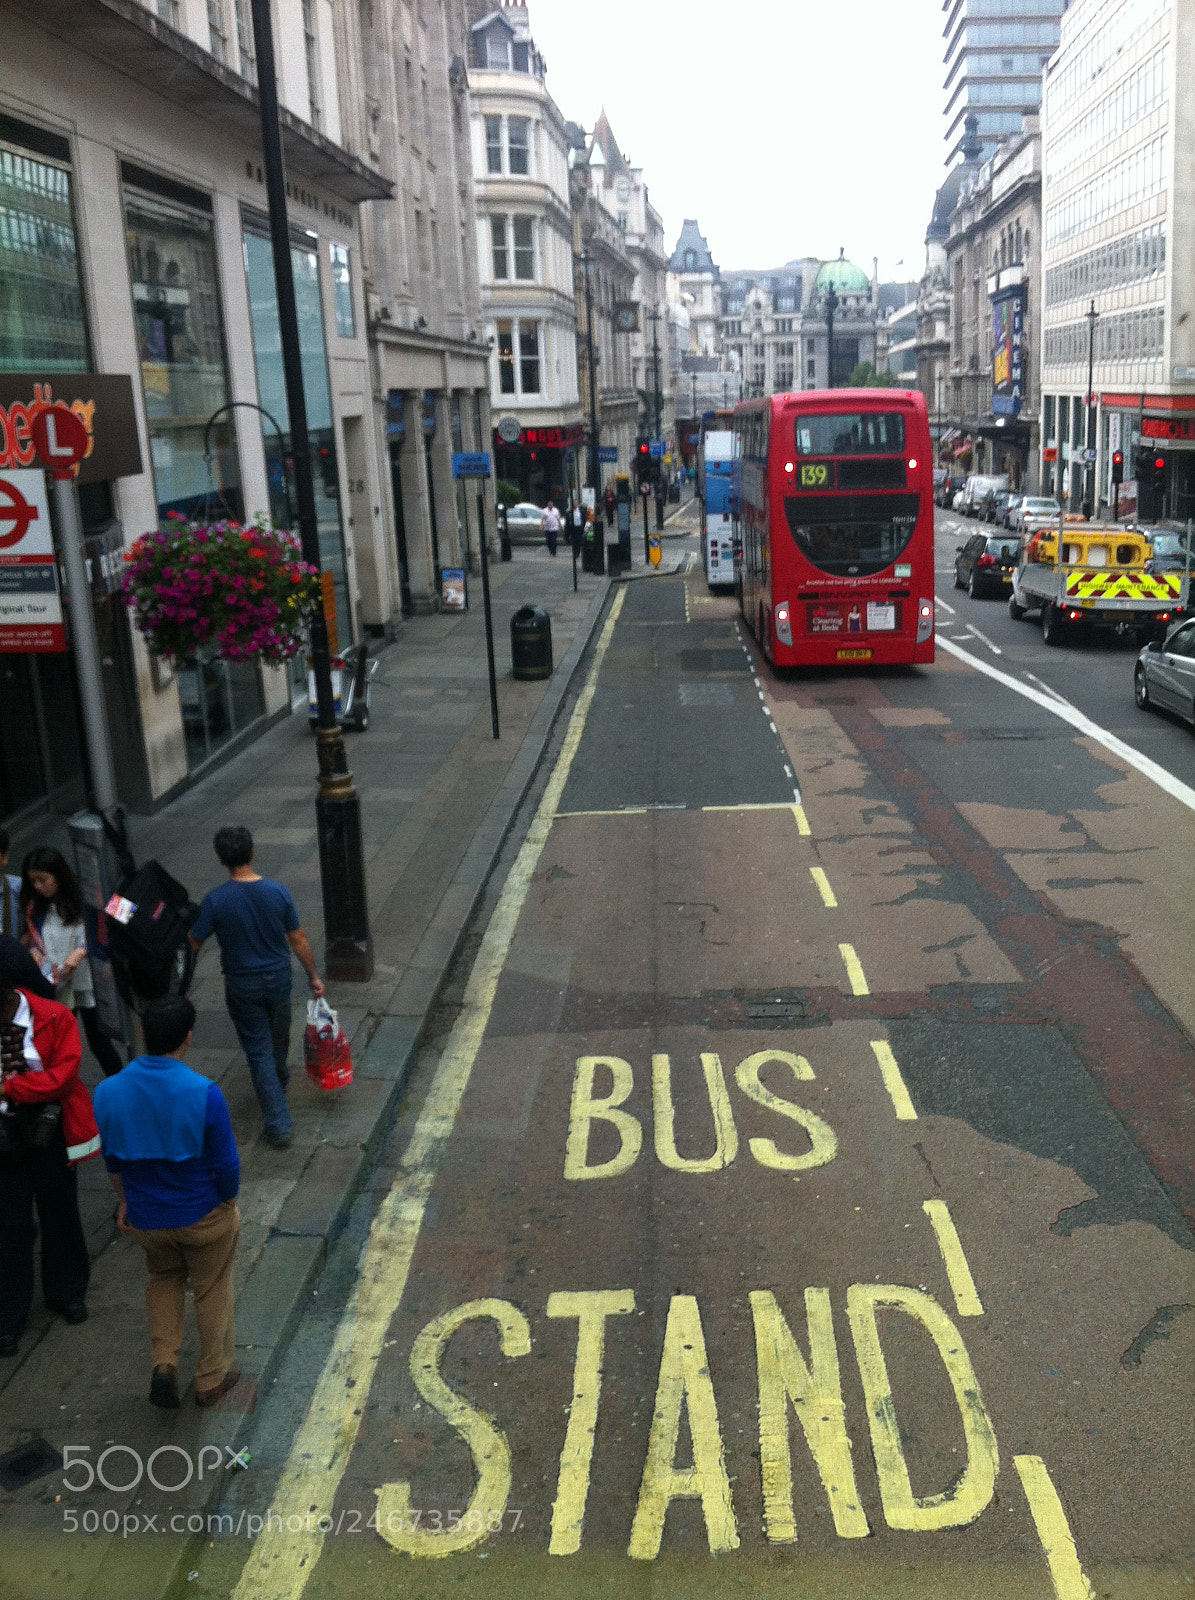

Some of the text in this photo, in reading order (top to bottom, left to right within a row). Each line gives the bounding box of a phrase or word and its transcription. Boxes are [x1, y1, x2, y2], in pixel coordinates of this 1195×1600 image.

[1011, 299, 1022, 398] CINEMA
[45, 413, 74, 457] L
[801, 465, 827, 486] 139
[564, 1050, 838, 1182] BUS
[374, 1283, 998, 1559] STAND
